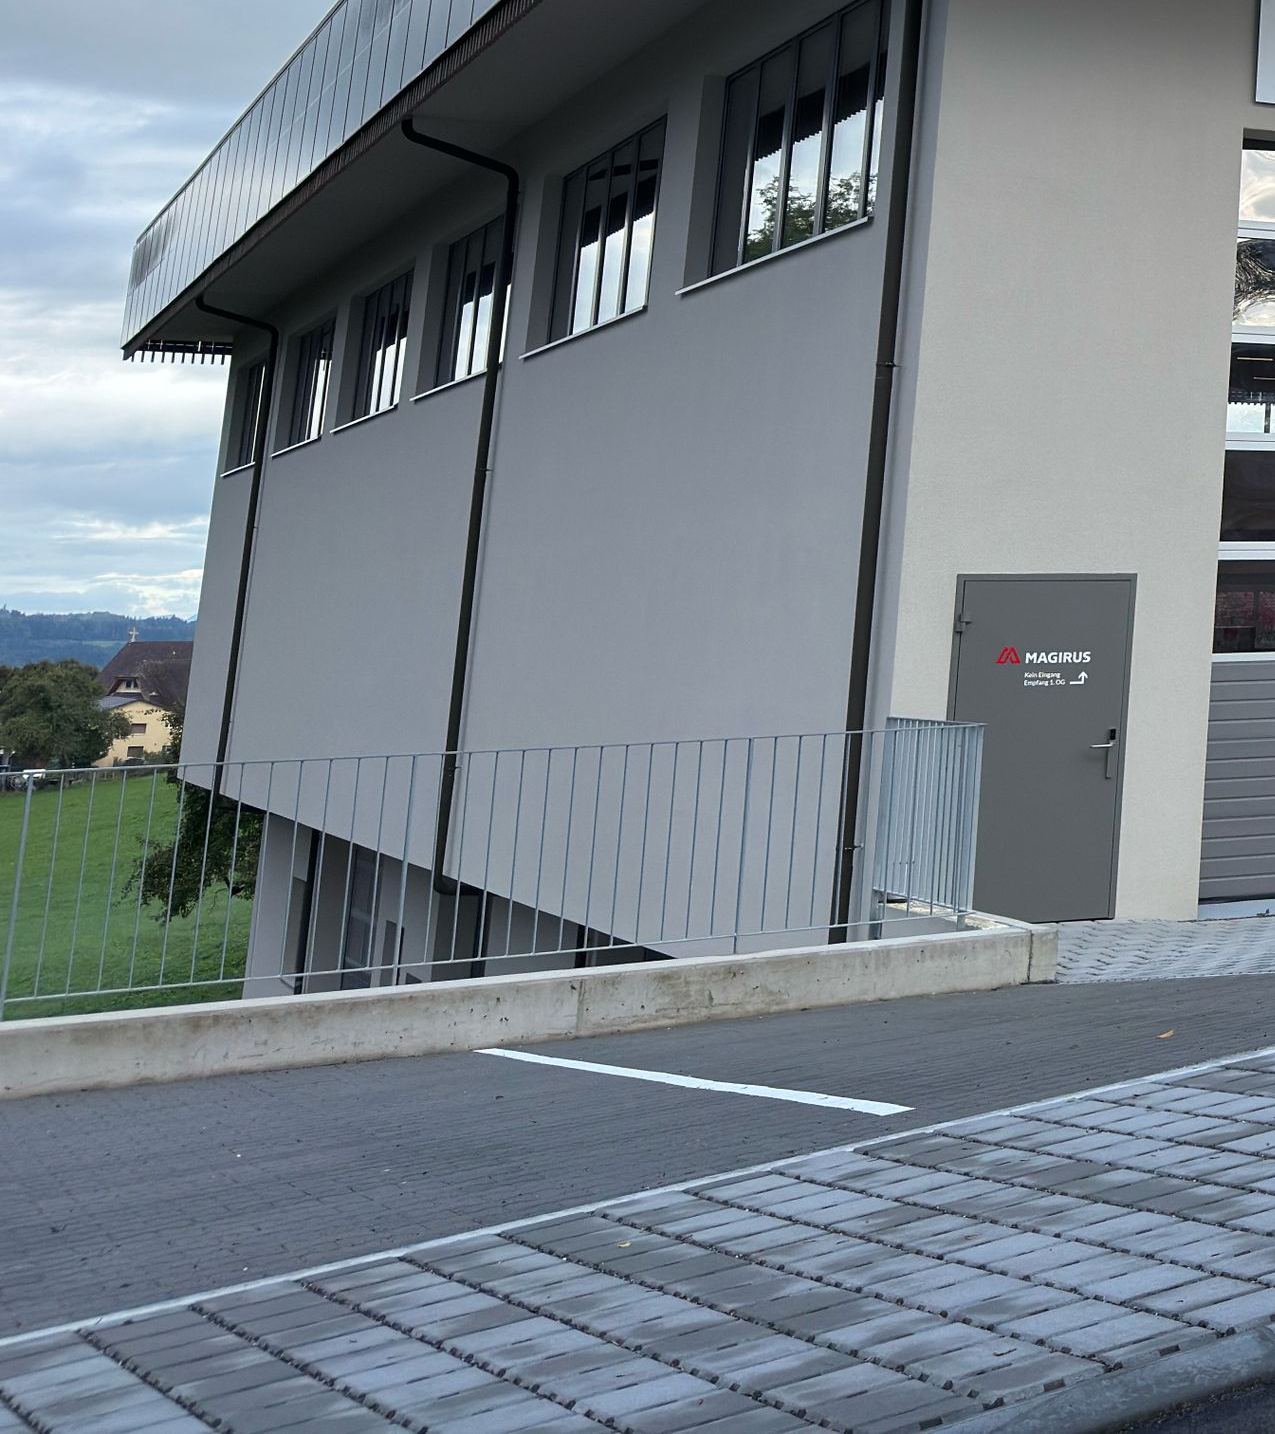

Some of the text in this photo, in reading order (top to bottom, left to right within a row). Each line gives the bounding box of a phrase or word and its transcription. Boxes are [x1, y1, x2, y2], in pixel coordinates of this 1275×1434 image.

[1025, 651, 1091, 664] MAGIRUS
[1038, 671, 1061, 679] Eingang
[1023, 679, 1049, 687] Empfang
